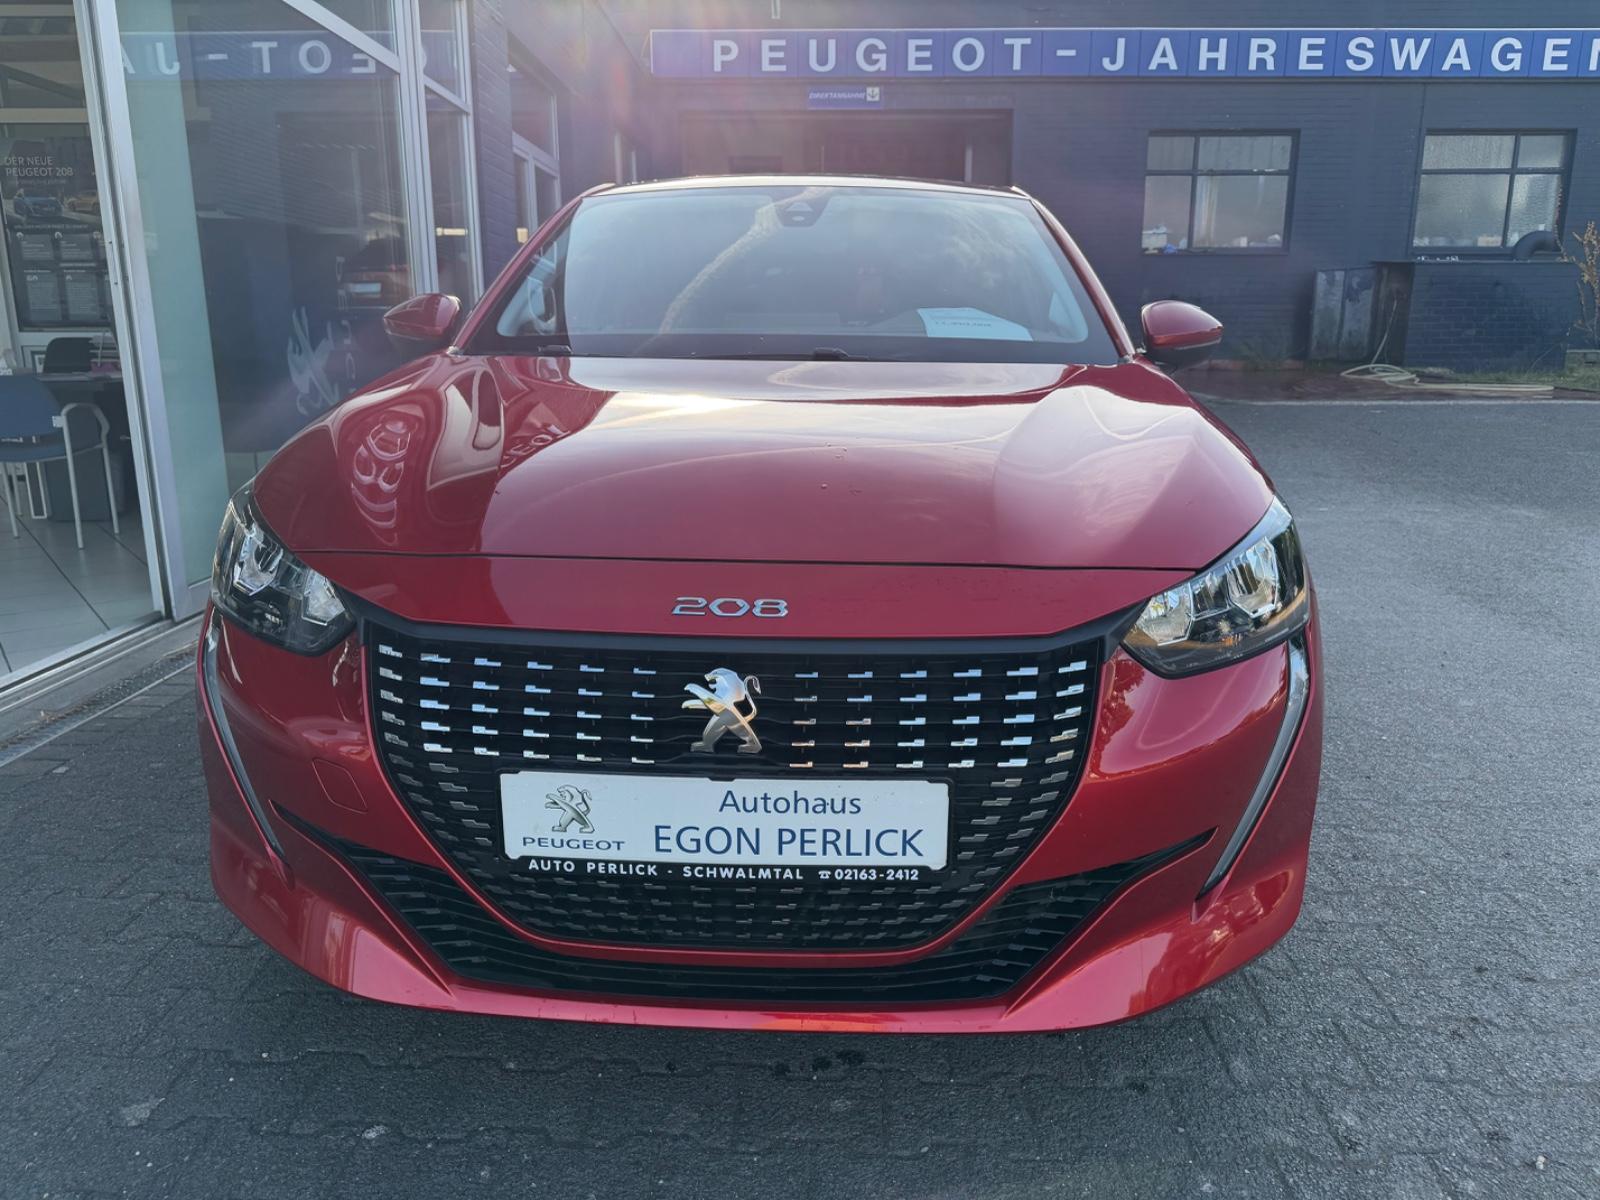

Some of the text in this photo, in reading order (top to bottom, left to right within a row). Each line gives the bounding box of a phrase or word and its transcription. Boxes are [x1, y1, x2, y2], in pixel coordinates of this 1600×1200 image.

[27, 155, 54, 166] NEUE
[6, 167, 74, 177] PEUGEOT 208
[671, 596, 789, 618] 208
[718, 790, 862, 815] Autohaus
[522, 836, 625, 851] PEUGEOT
[654, 824, 924, 857] EGON PERLICK
[528, 859, 576, 873] AUTO
[586, 862, 658, 877] PERLICK
[682, 866, 804, 880] SCHWALMTAL
[834, 868, 919, 881] 02163-2412
